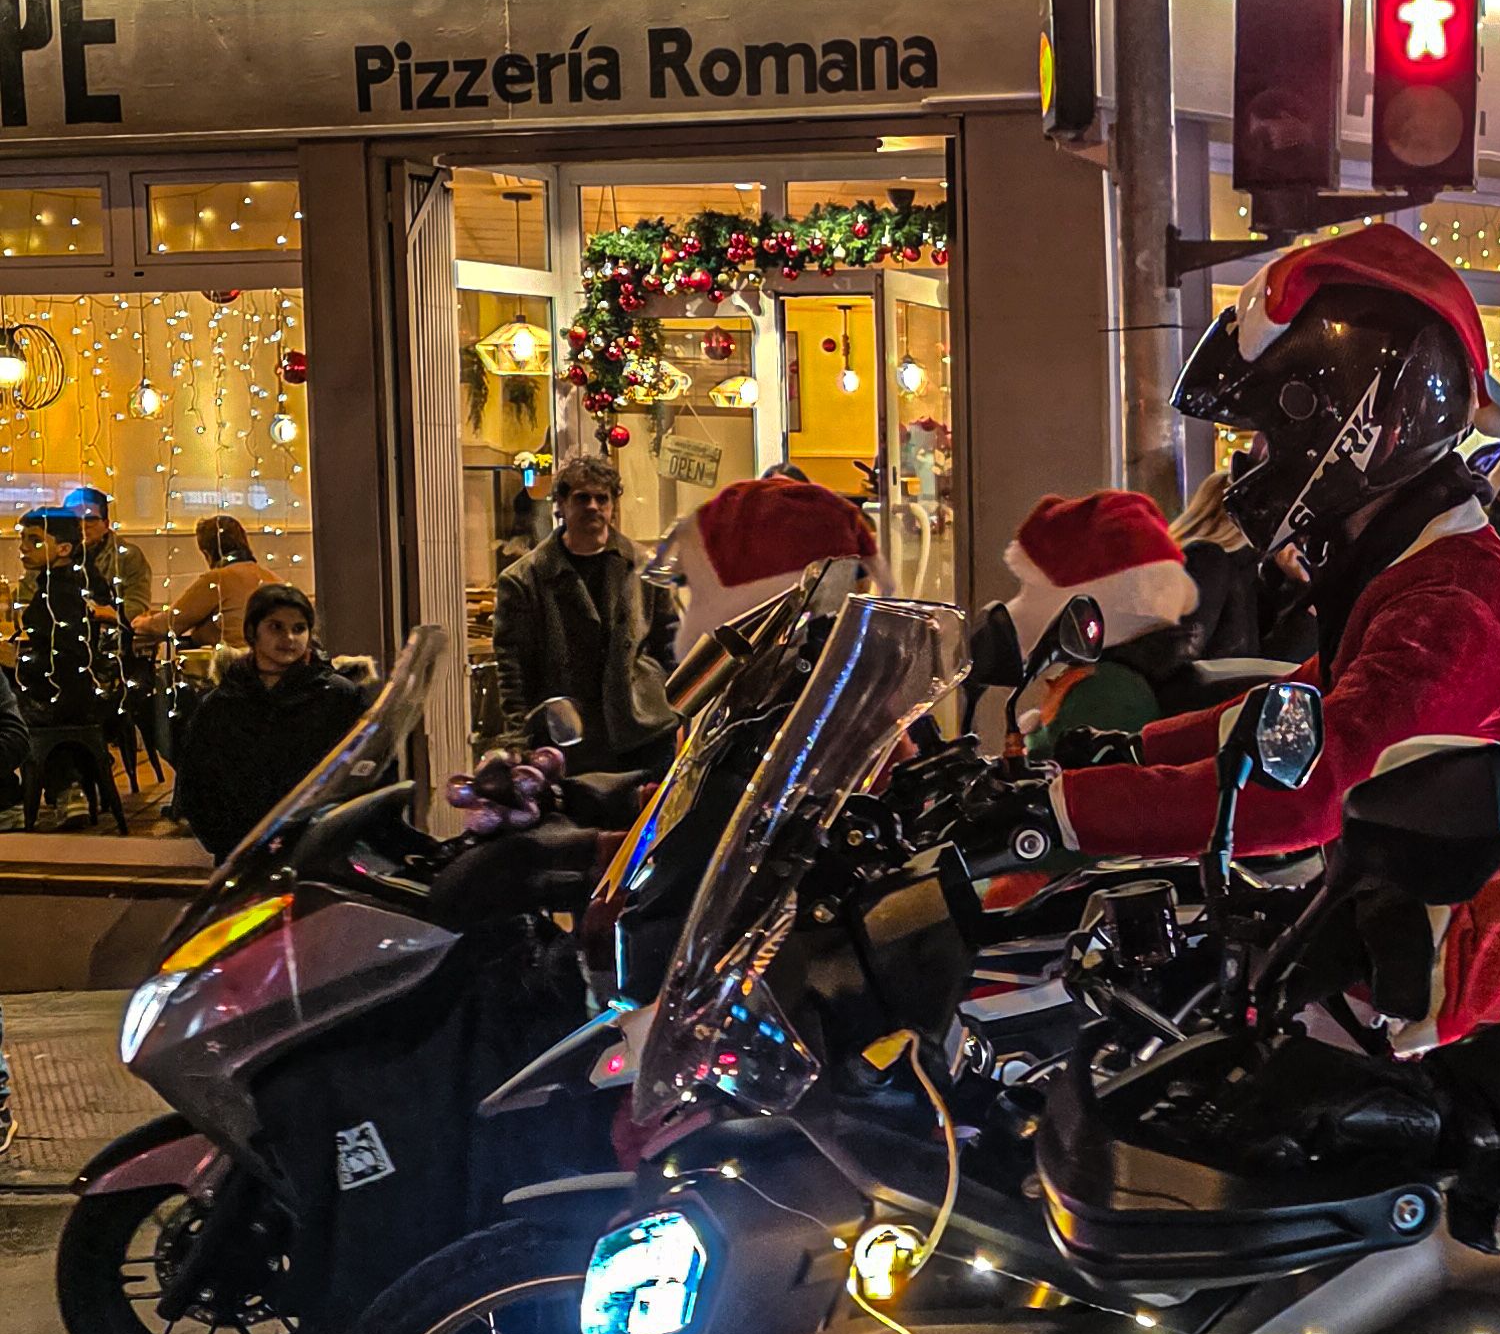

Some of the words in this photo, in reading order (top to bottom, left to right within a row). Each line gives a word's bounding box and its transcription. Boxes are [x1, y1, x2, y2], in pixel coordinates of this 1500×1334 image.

[354, 27, 622, 113] Pizzería
[647, 26, 939, 100] Romana
[669, 455, 706, 481] OPEN
